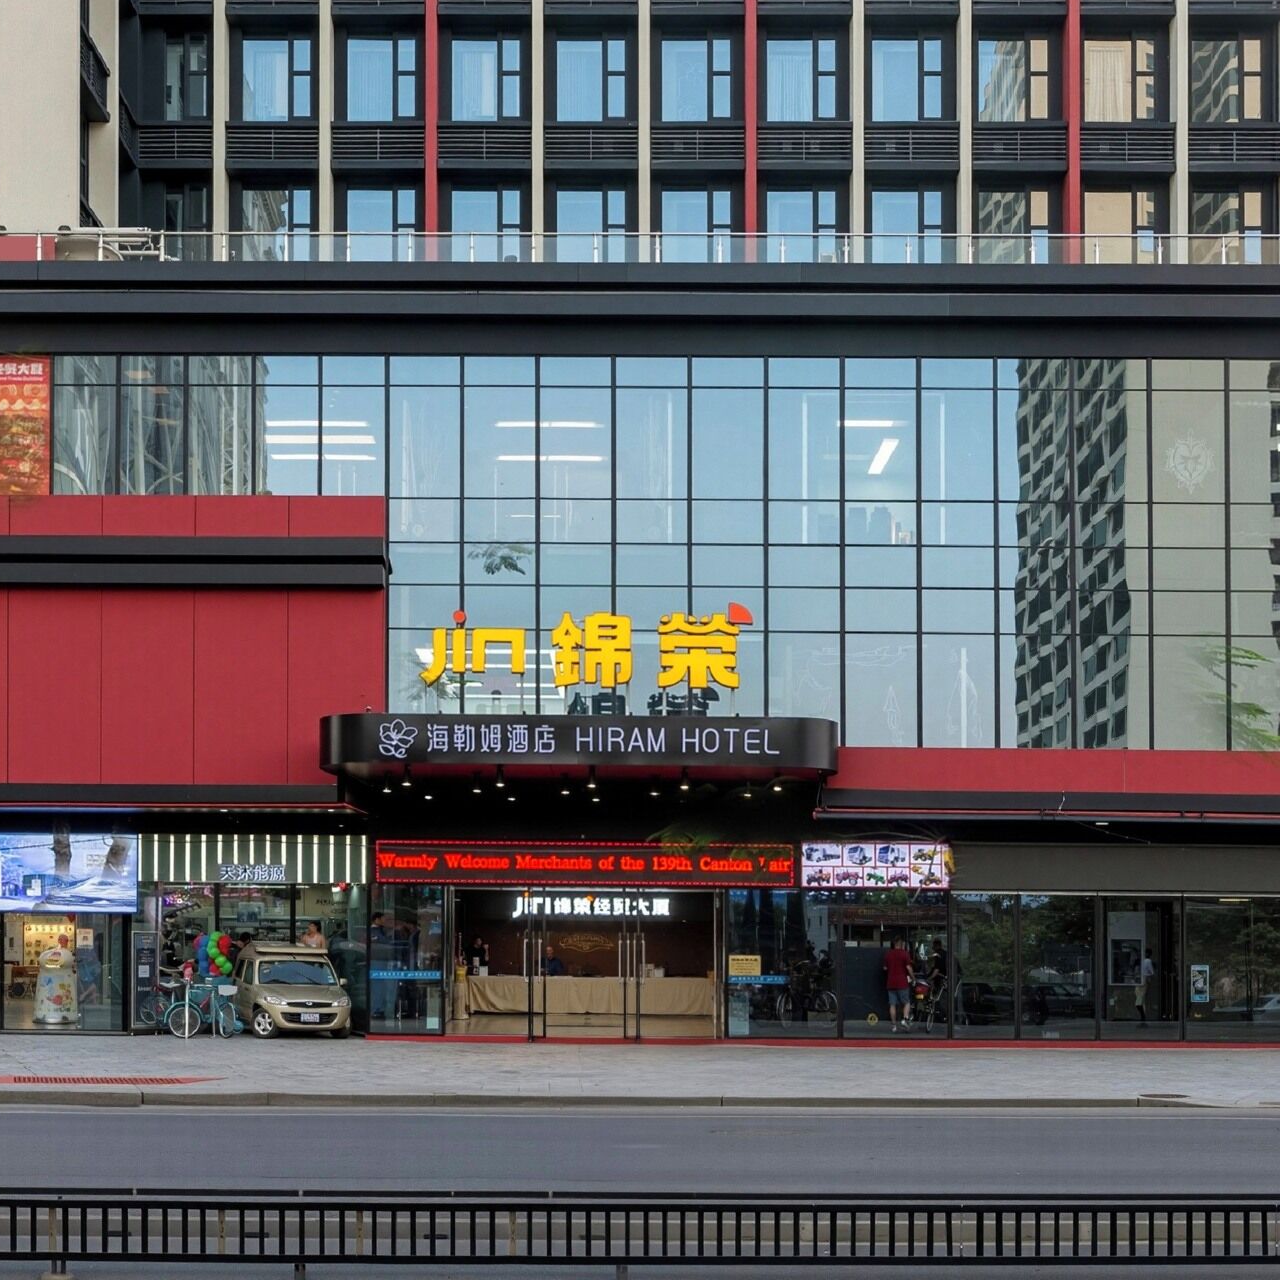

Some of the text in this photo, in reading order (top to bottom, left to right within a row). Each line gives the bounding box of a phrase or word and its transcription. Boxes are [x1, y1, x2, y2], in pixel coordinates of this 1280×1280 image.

[426, 723, 780, 756] 海勒姆酒店 HIRAM HOTEL
[378, 853, 437, 870] Warmly
[444, 853, 510, 869] Welcome
[515, 854, 592, 870] Merchants
[598, 855, 615, 870] of
[621, 855, 645, 870] the
[651, 856, 693, 872] 139th
[699, 857, 752, 871] Canton
[220, 864, 286, 881] 天沐能源
